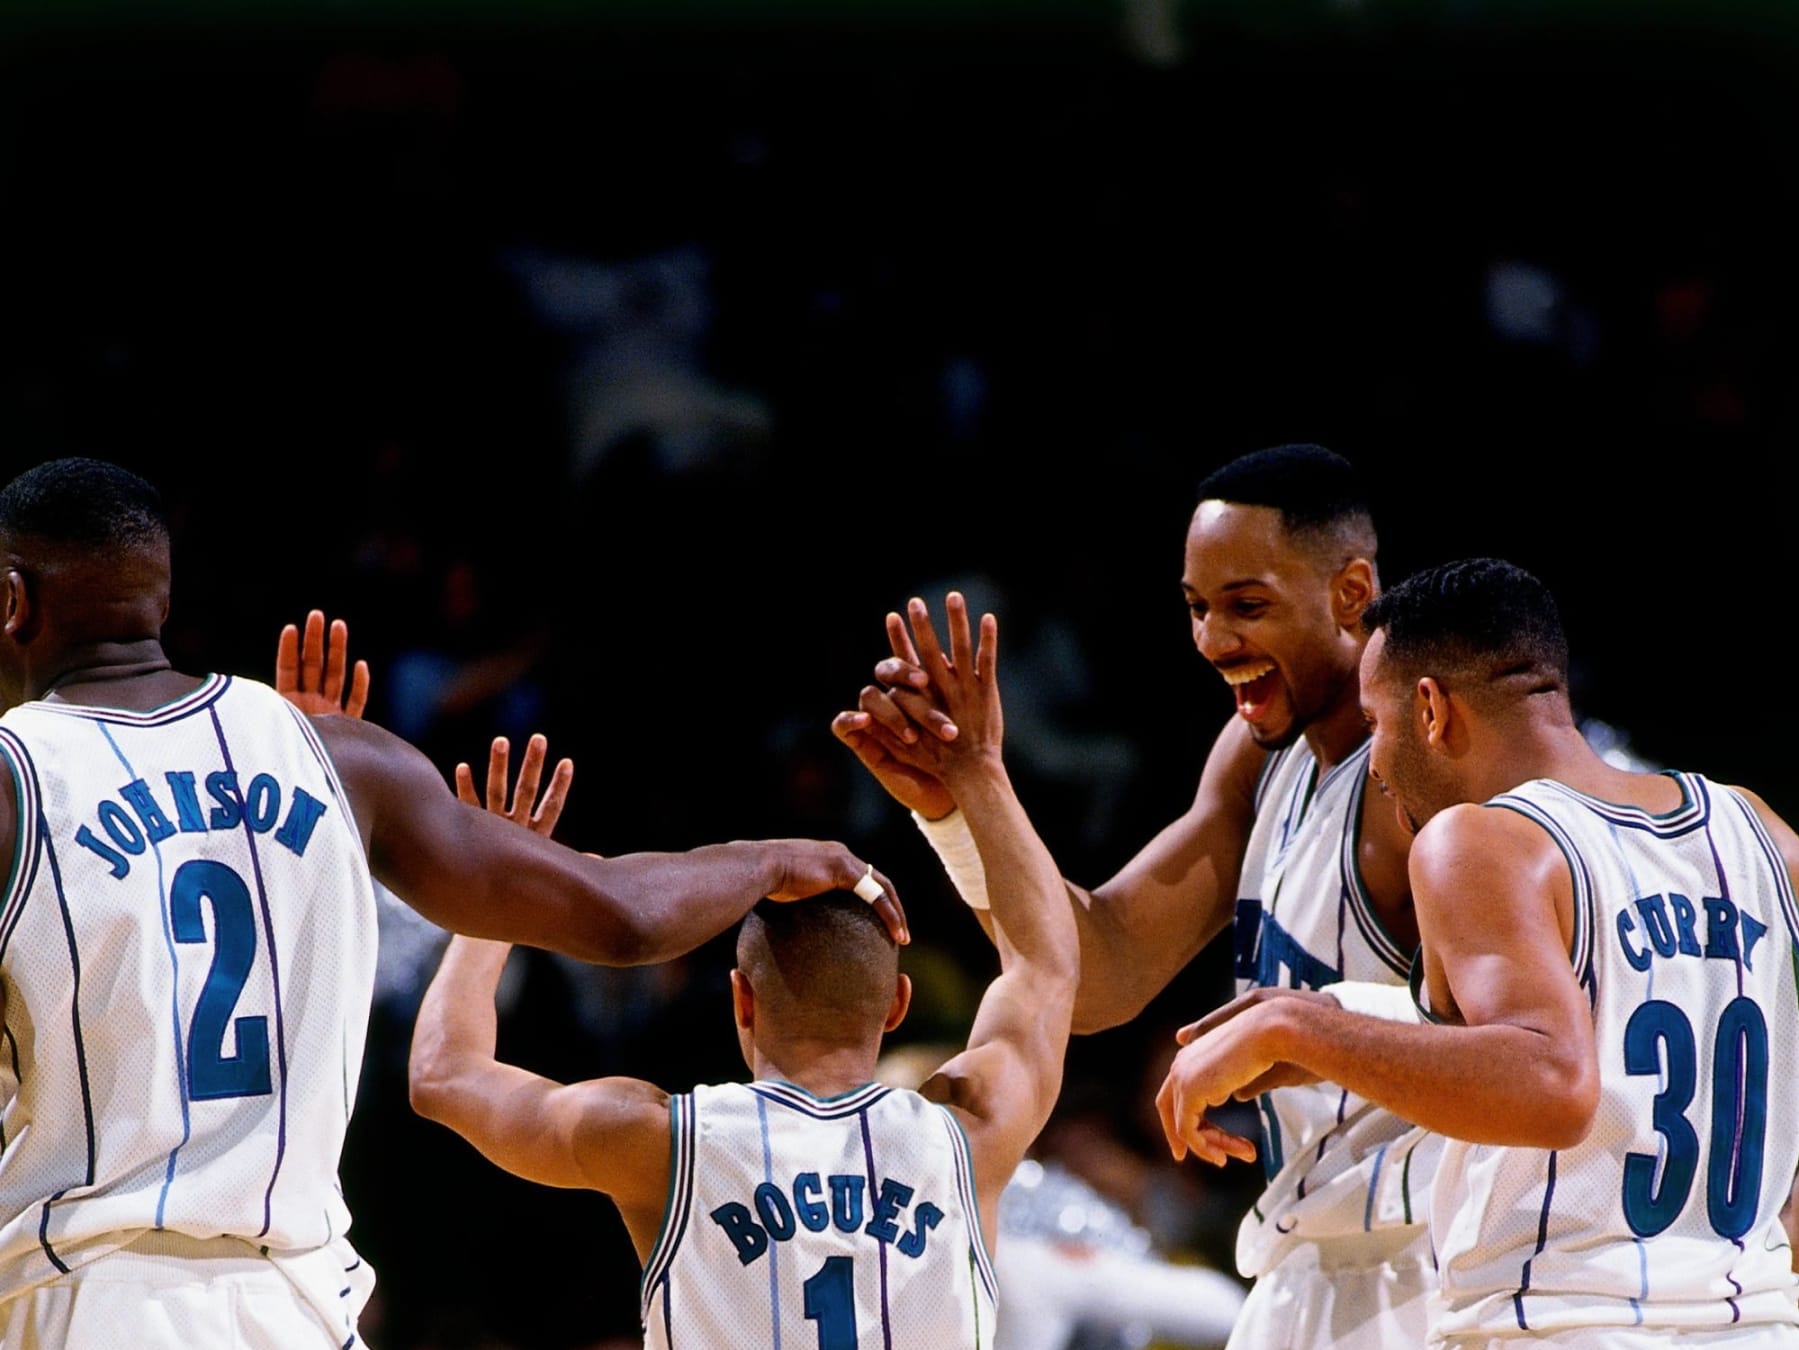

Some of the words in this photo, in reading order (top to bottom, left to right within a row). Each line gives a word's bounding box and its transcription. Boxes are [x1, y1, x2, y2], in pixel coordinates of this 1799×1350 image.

[75, 770, 327, 880] JOHNSON
[170, 859, 273, 1102] 2
[1616, 893, 1768, 973] CURRY
[1622, 997, 1769, 1240] 30
[710, 1172, 945, 1266] BOGUES
